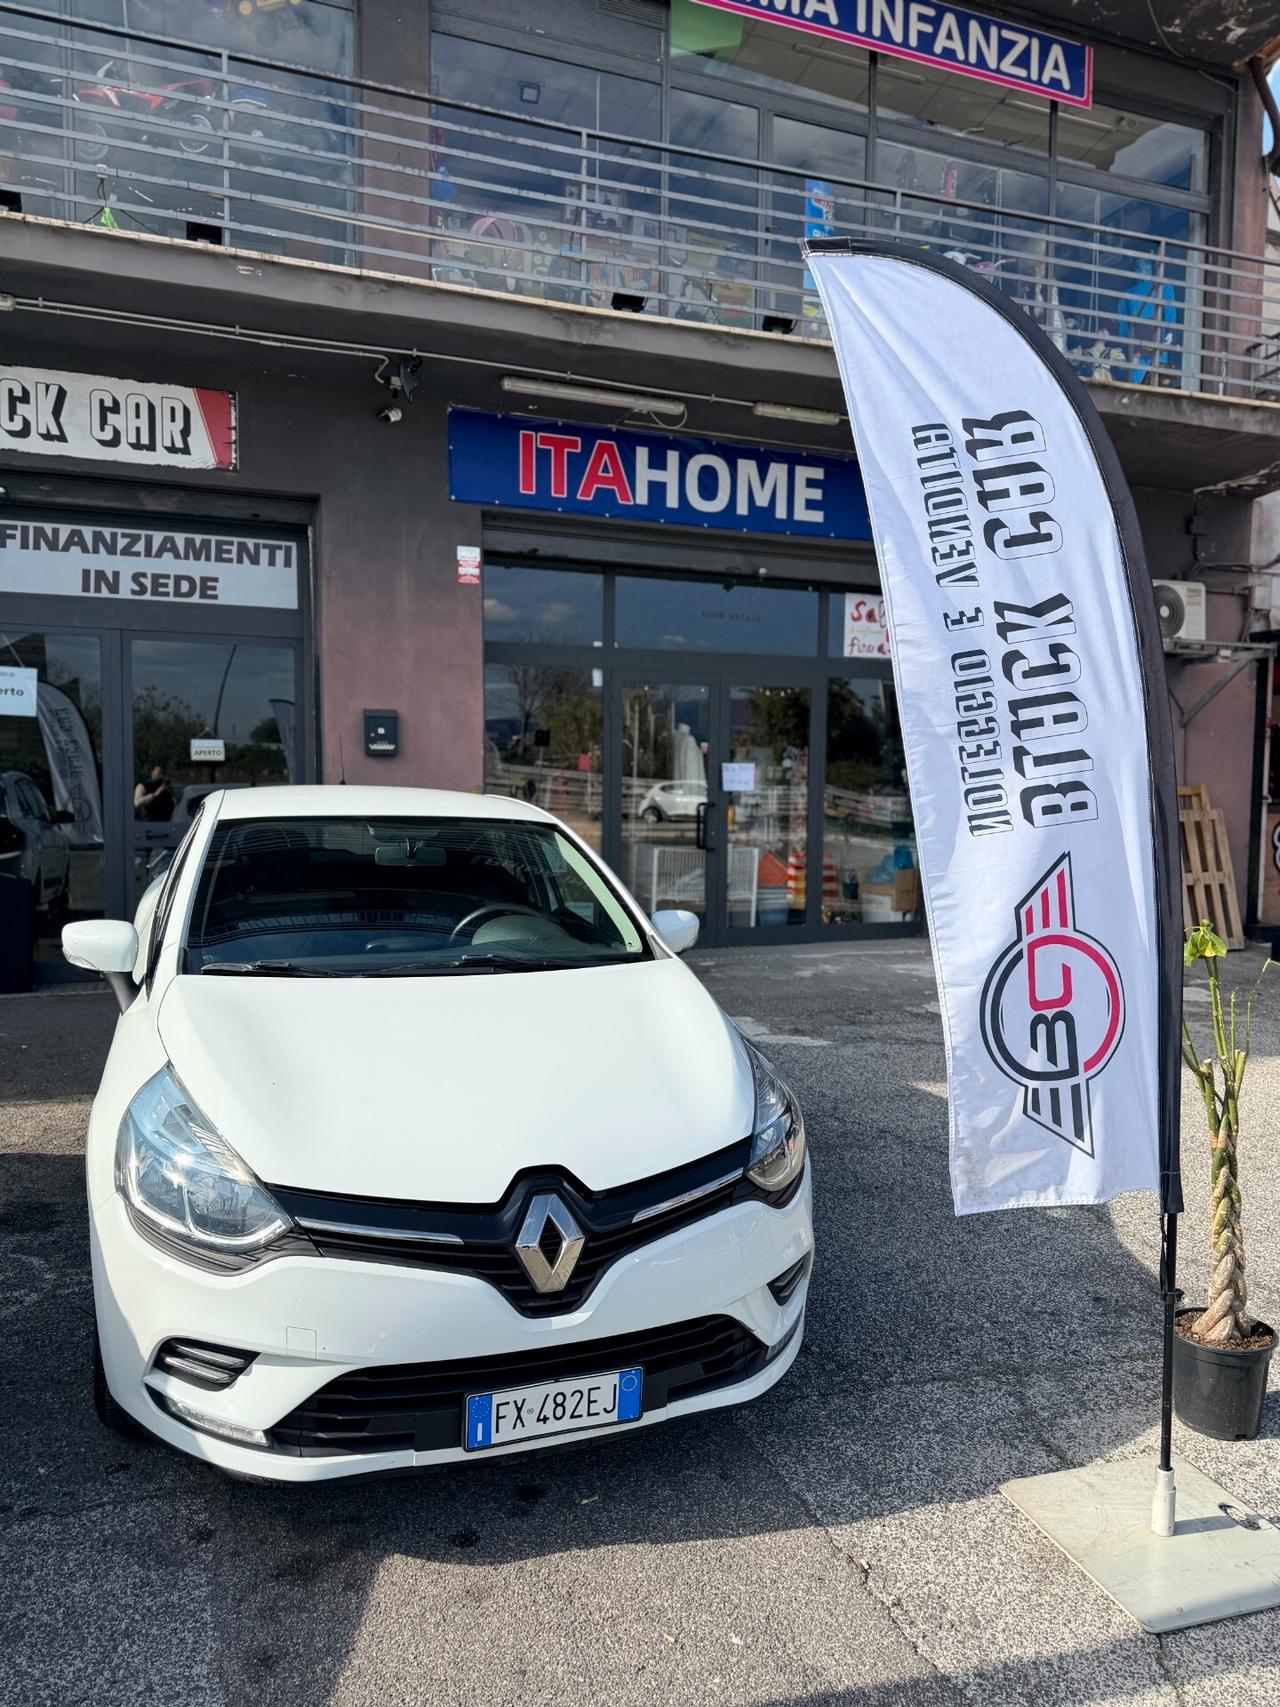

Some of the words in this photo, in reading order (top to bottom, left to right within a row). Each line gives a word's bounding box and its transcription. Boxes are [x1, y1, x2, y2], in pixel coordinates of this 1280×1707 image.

[857, 0, 1071, 91] INFANZIA
[89, 388, 192, 456] CAR
[518, 430, 825, 523] ITAHOME
[0, 524, 292, 569] FINANZIAMENTI
[81, 568, 120, 595] IN
[130, 571, 219, 600] SEDE
